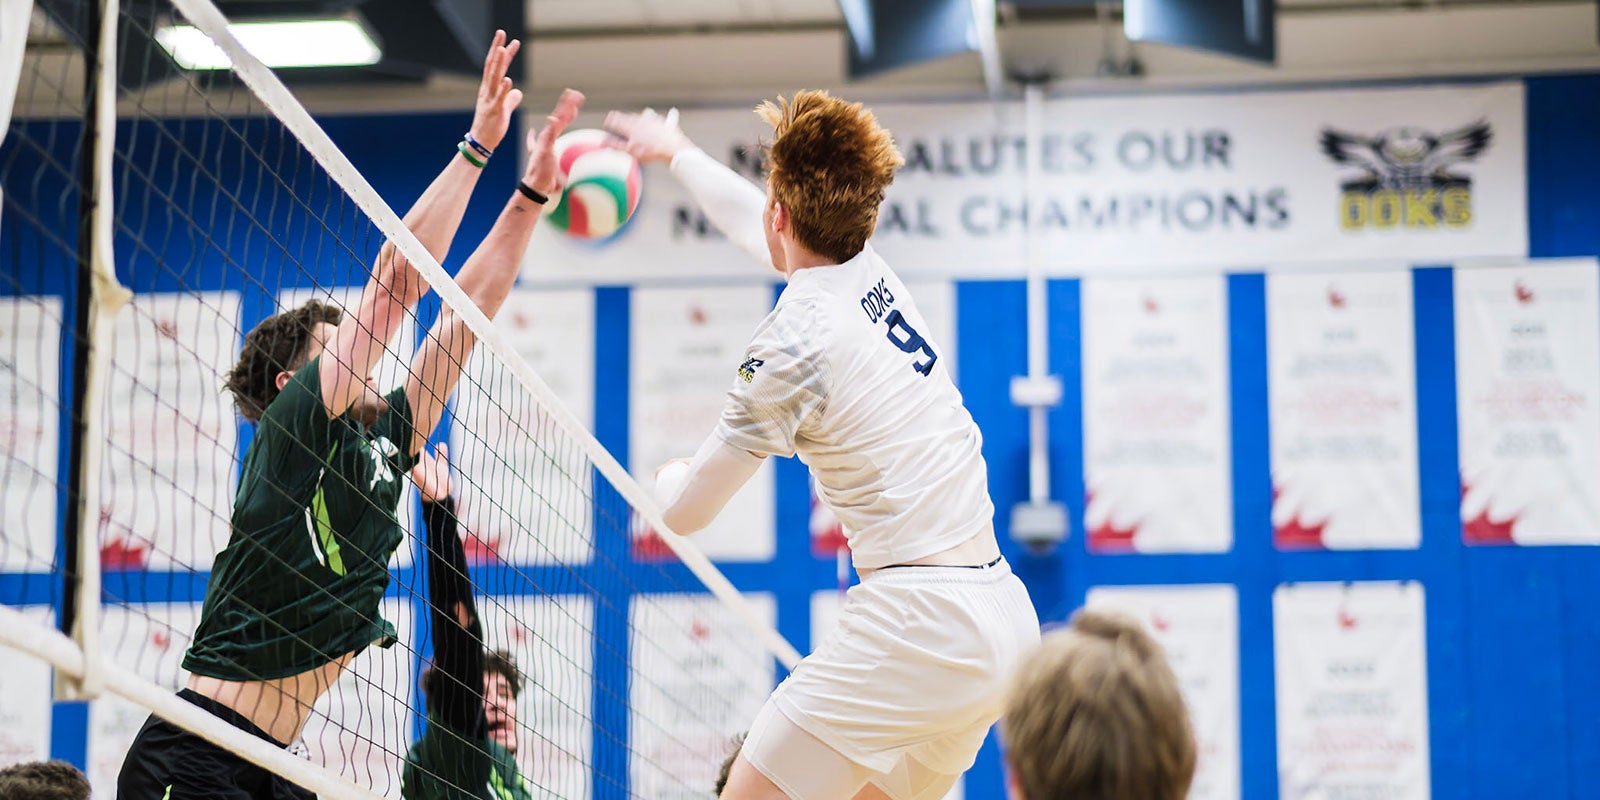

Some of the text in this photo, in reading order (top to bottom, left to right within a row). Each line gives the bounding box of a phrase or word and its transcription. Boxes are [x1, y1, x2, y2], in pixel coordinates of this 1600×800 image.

[902, 130, 1232, 178] ALUTES OUR
[960, 188, 1289, 236] CHAMPIONS
[1340, 188, 1472, 229] OOKS
[861, 277, 894, 323] OOKS
[884, 309, 937, 377] 9
